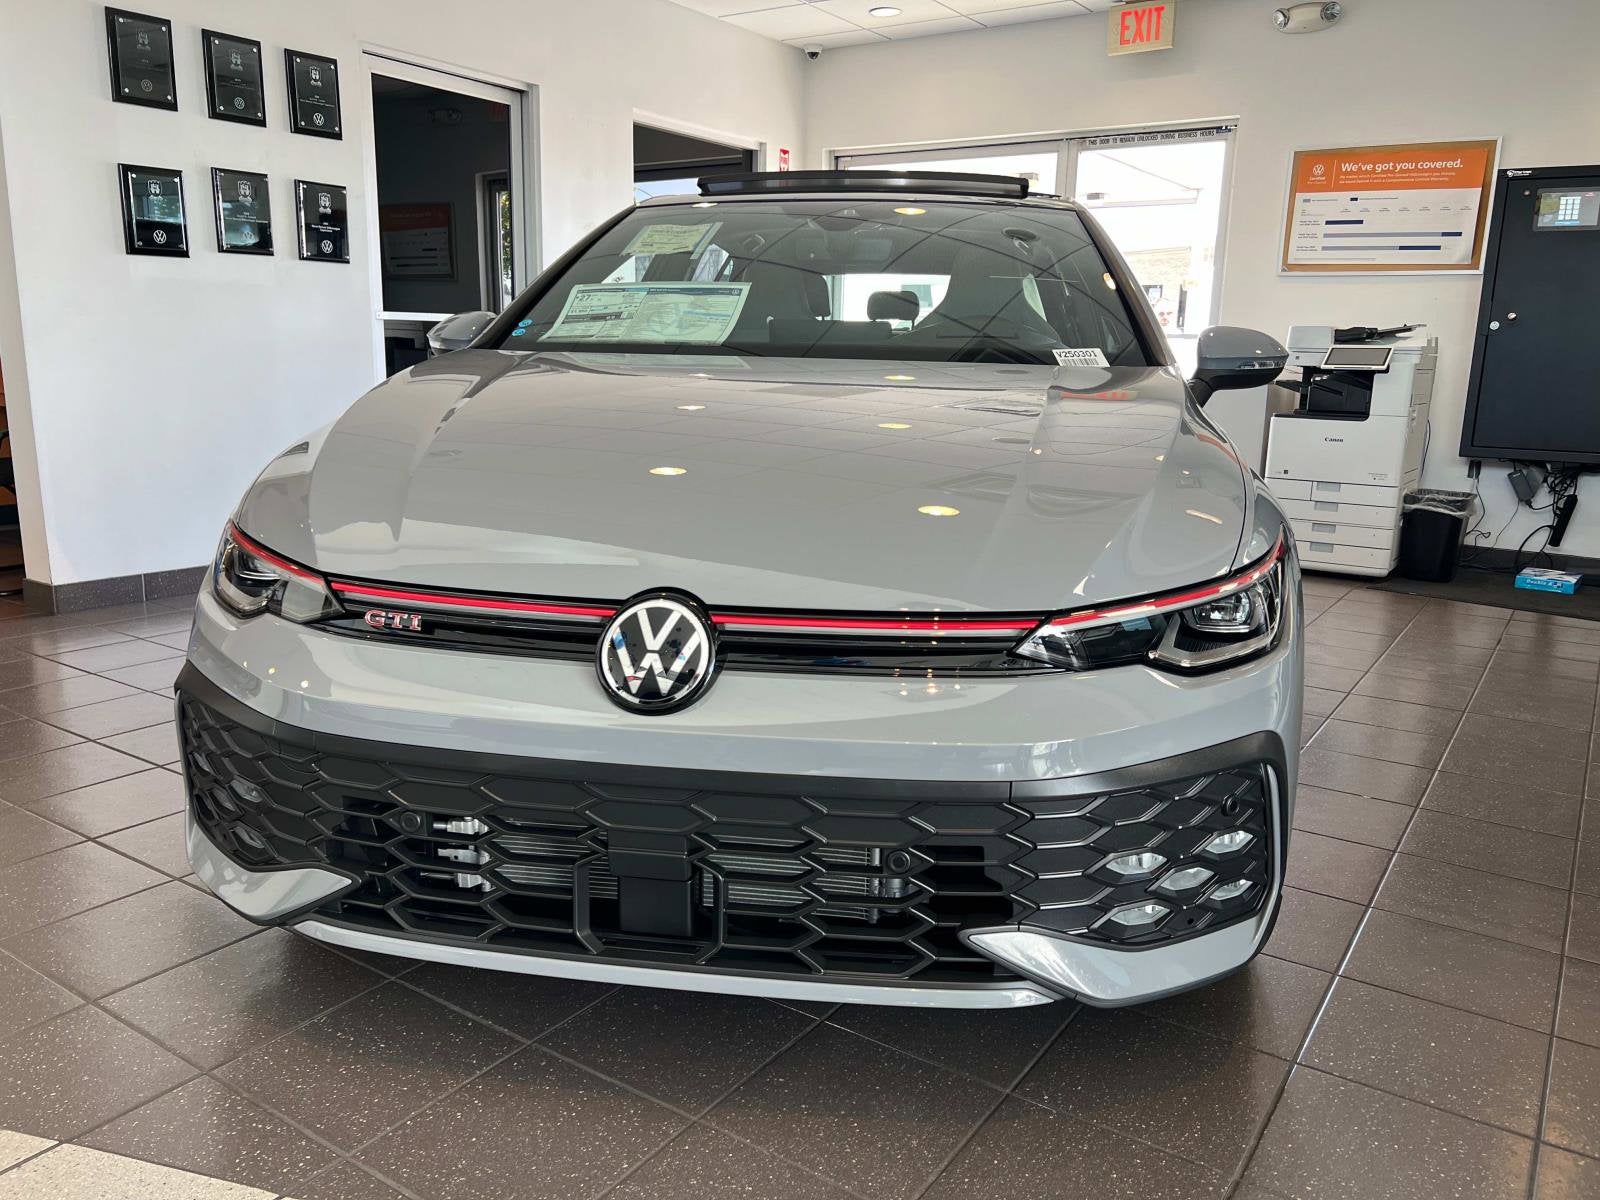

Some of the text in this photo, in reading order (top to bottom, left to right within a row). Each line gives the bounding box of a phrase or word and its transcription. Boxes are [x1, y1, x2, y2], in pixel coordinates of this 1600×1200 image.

[1120, 5, 1165, 45] EXIT
[1137, 134, 1158, 142] UNLOCKED
[1178, 131, 1198, 139] BUSINESS
[1341, 158, 1463, 173] We've got you covered.
[1055, 350, 1098, 358] V250301
[365, 609, 422, 632] GTI
[603, 600, 708, 702] VW
